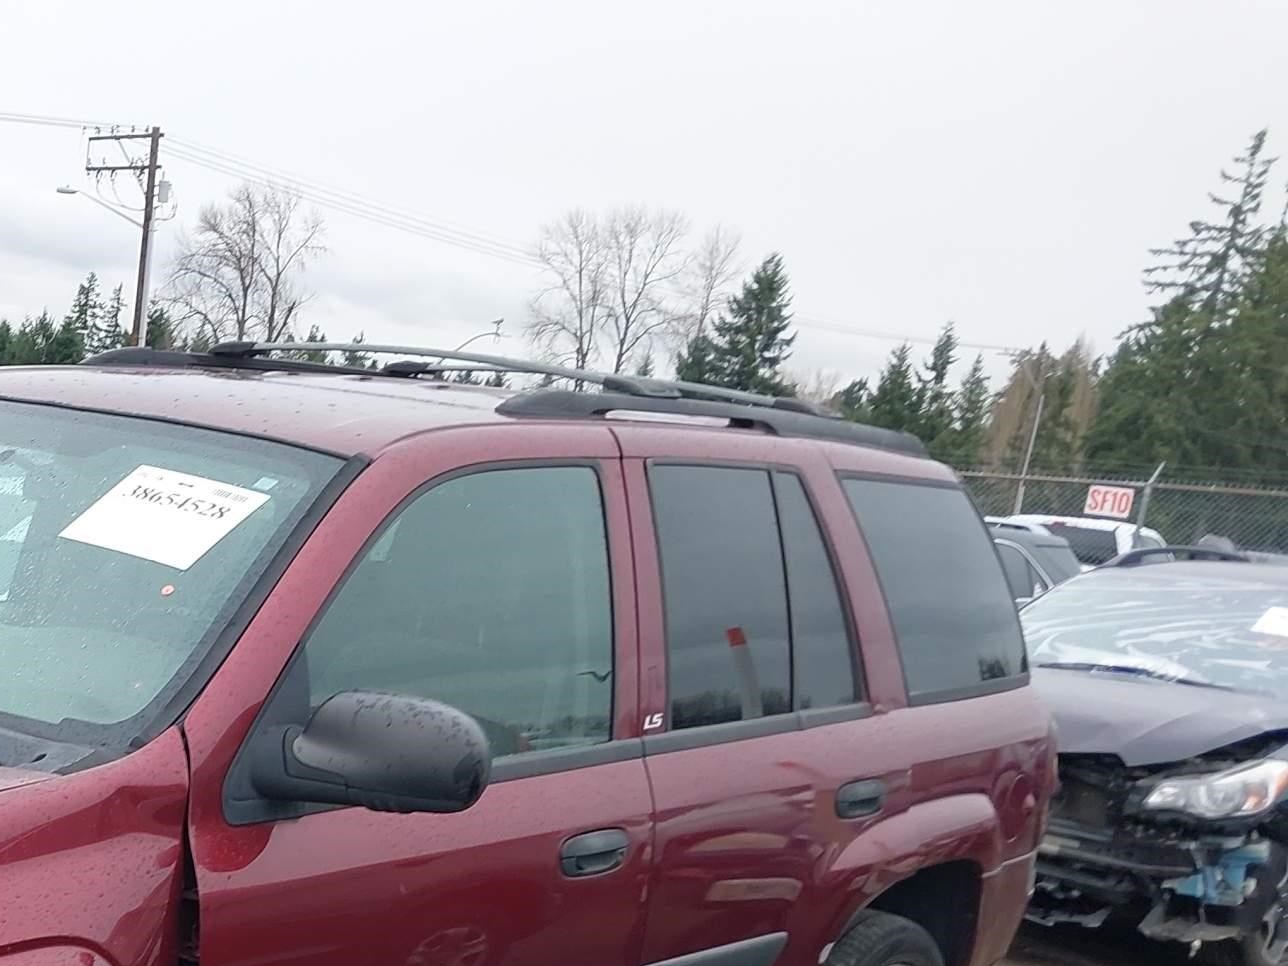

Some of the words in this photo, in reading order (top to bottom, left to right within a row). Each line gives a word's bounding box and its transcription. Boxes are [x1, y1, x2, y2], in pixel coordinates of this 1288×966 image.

[121, 484, 231, 520] 38654528
[1088, 489, 1130, 514] SF10
[643, 712, 665, 730] LS
